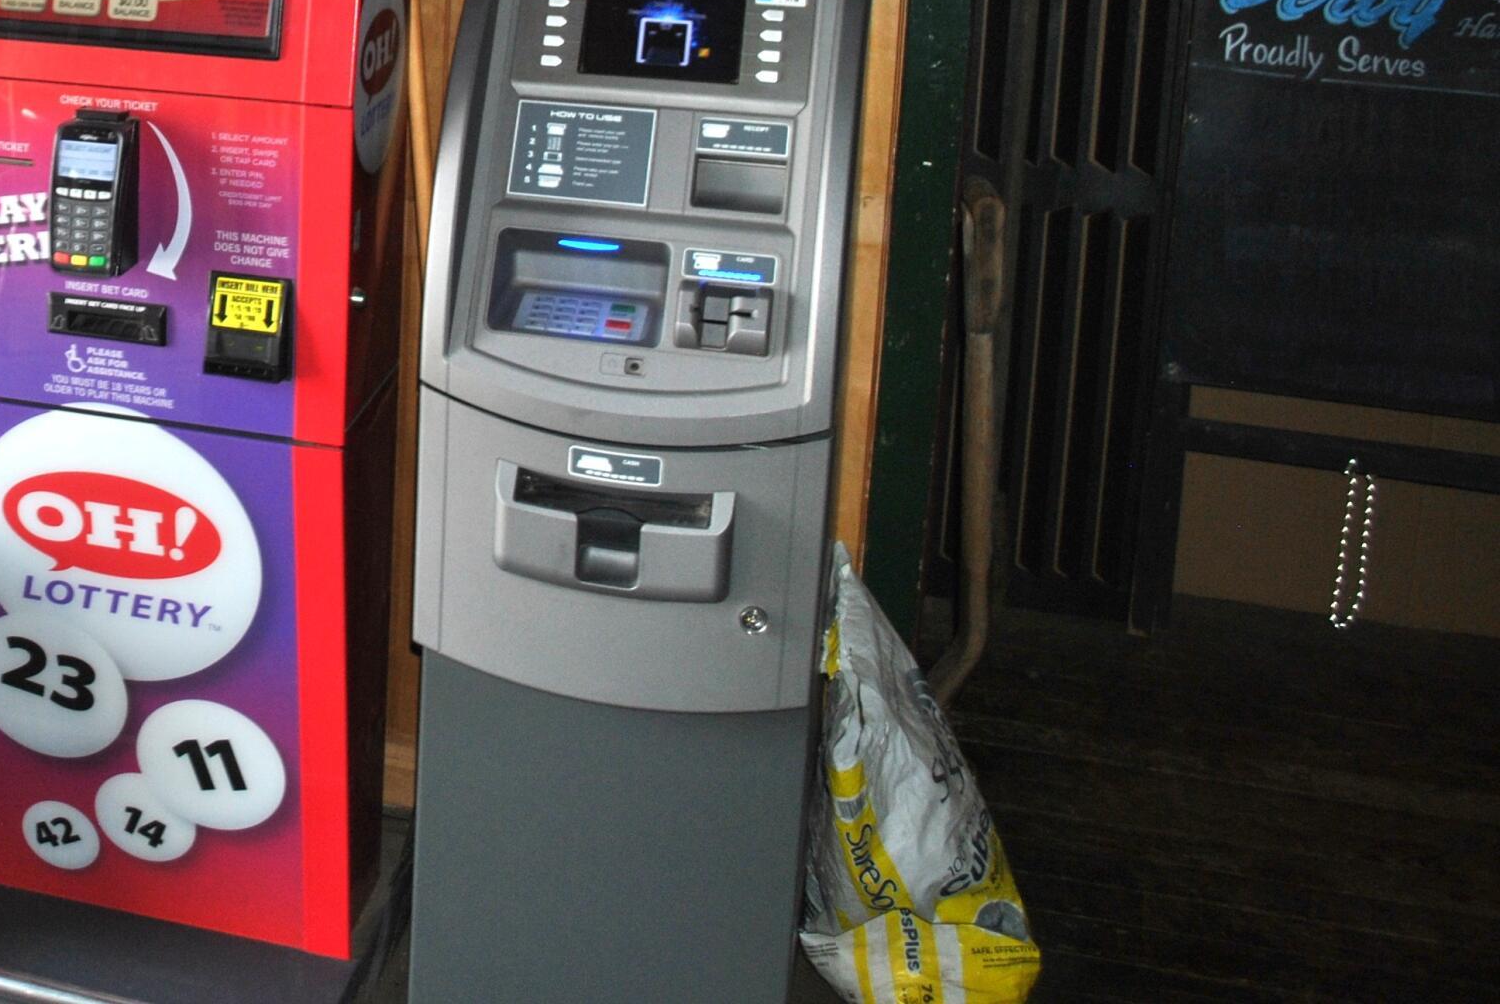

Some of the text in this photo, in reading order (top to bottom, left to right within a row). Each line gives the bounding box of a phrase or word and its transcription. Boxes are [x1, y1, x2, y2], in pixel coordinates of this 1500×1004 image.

[363, 18, 397, 81] OH!
[1219, 22, 1425, 79] Proudly Serves
[60, 95, 158, 111] CHECK YOUR TICKET
[550, 110, 577, 119] HOW
[578, 112, 595, 121] TO
[218, 132, 249, 142] SELECT
[251, 135, 288, 145] AMOUNT
[216, 230, 288, 246] THIS MACHINE
[214, 242, 290, 258] DOES NOT GIVE
[230, 255, 273, 268] CHANGE
[65, 281, 149, 298] INSERT BET CARD
[86, 347, 124, 358] PLEASE
[86, 357, 128, 369] ASK FOR
[43, 383, 175, 409] OLDER TO PLAY THIS MACHINE
[52, 374, 69, 384] YOU
[70, 376, 95, 387] MUST
[97, 379, 110, 390] BE
[124, 383, 151, 395] YEARS
[153, 387, 167, 397] OR
[17, 490, 197, 562] OH!
[22, 575, 212, 630] LOTTERY
[1, 635, 96, 712] 23
[173, 739, 248, 792] 11
[35, 817, 81, 848] 42
[124, 806, 167, 848] 14
